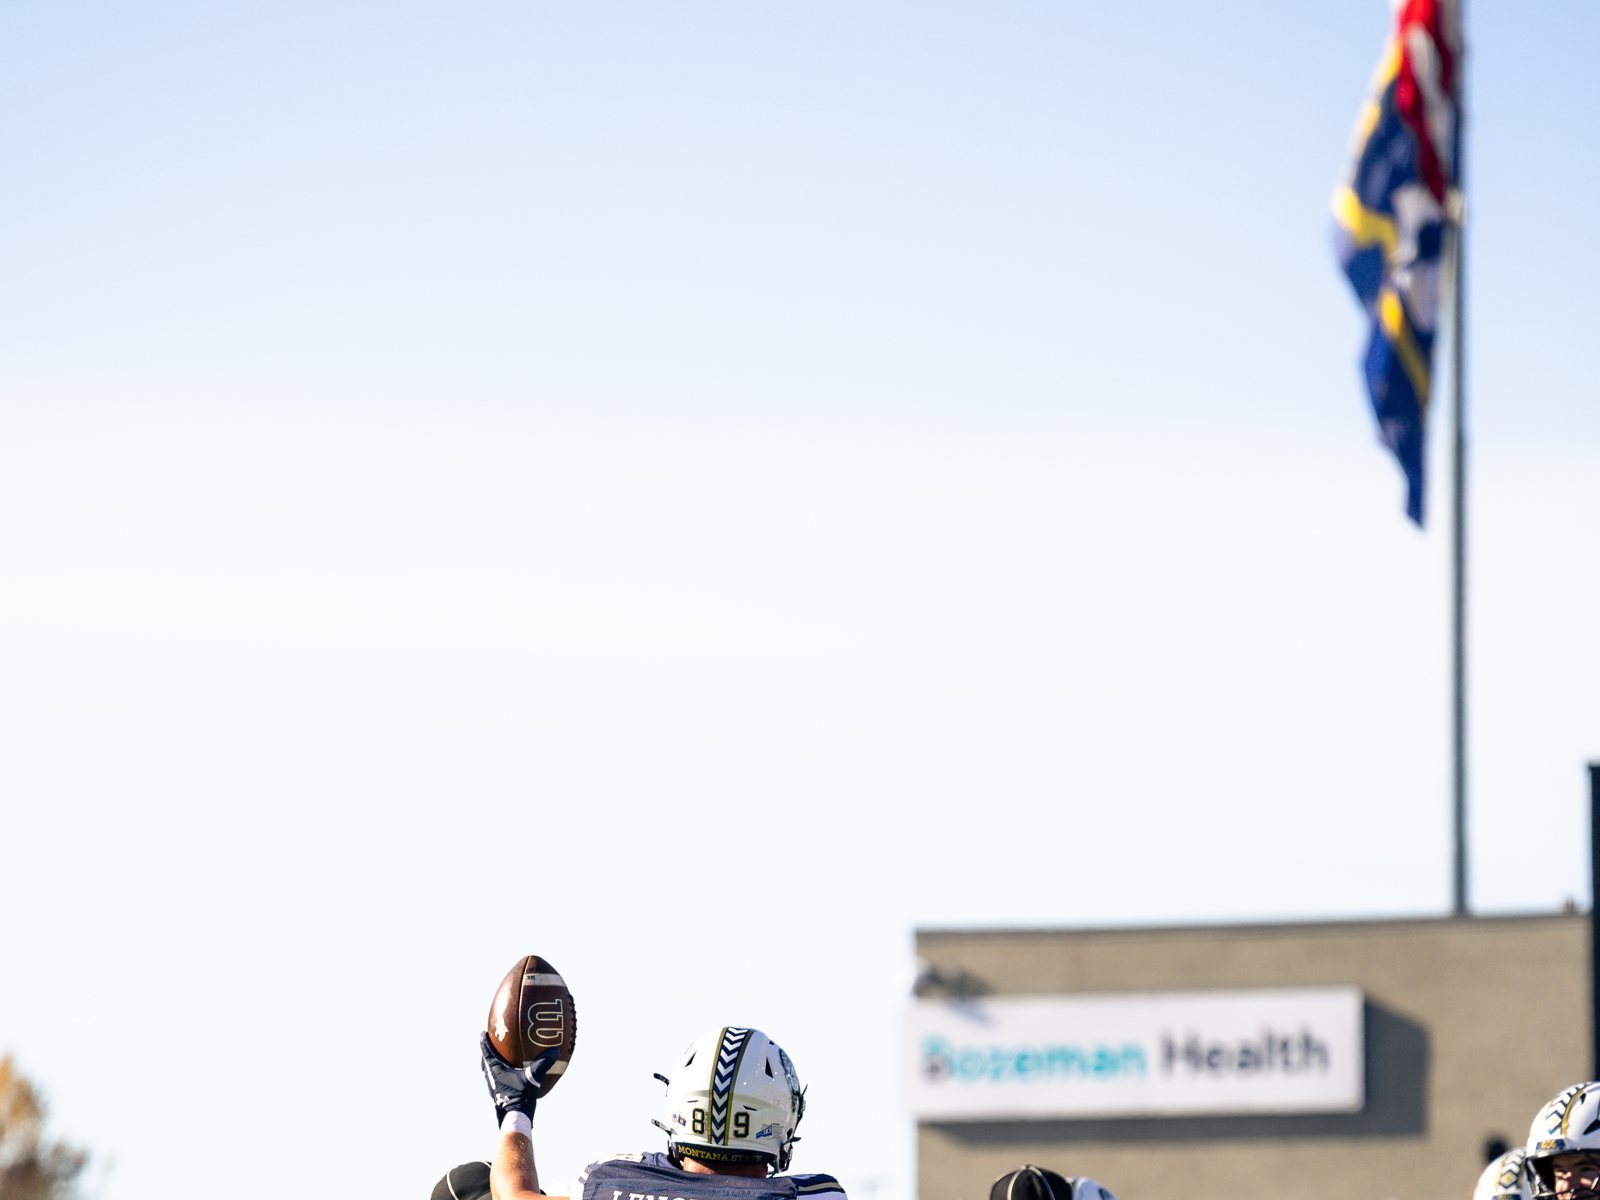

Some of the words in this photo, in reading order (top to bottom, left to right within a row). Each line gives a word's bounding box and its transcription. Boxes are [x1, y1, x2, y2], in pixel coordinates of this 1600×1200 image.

[527, 998, 564, 1048] W
[921, 1035, 1147, 1083] Bozeman
[1160, 1028, 1330, 1076] Health
[692, 1107, 705, 1135] 8
[733, 1111, 750, 1139] 9
[677, 1144, 729, 1162] MONTANA
